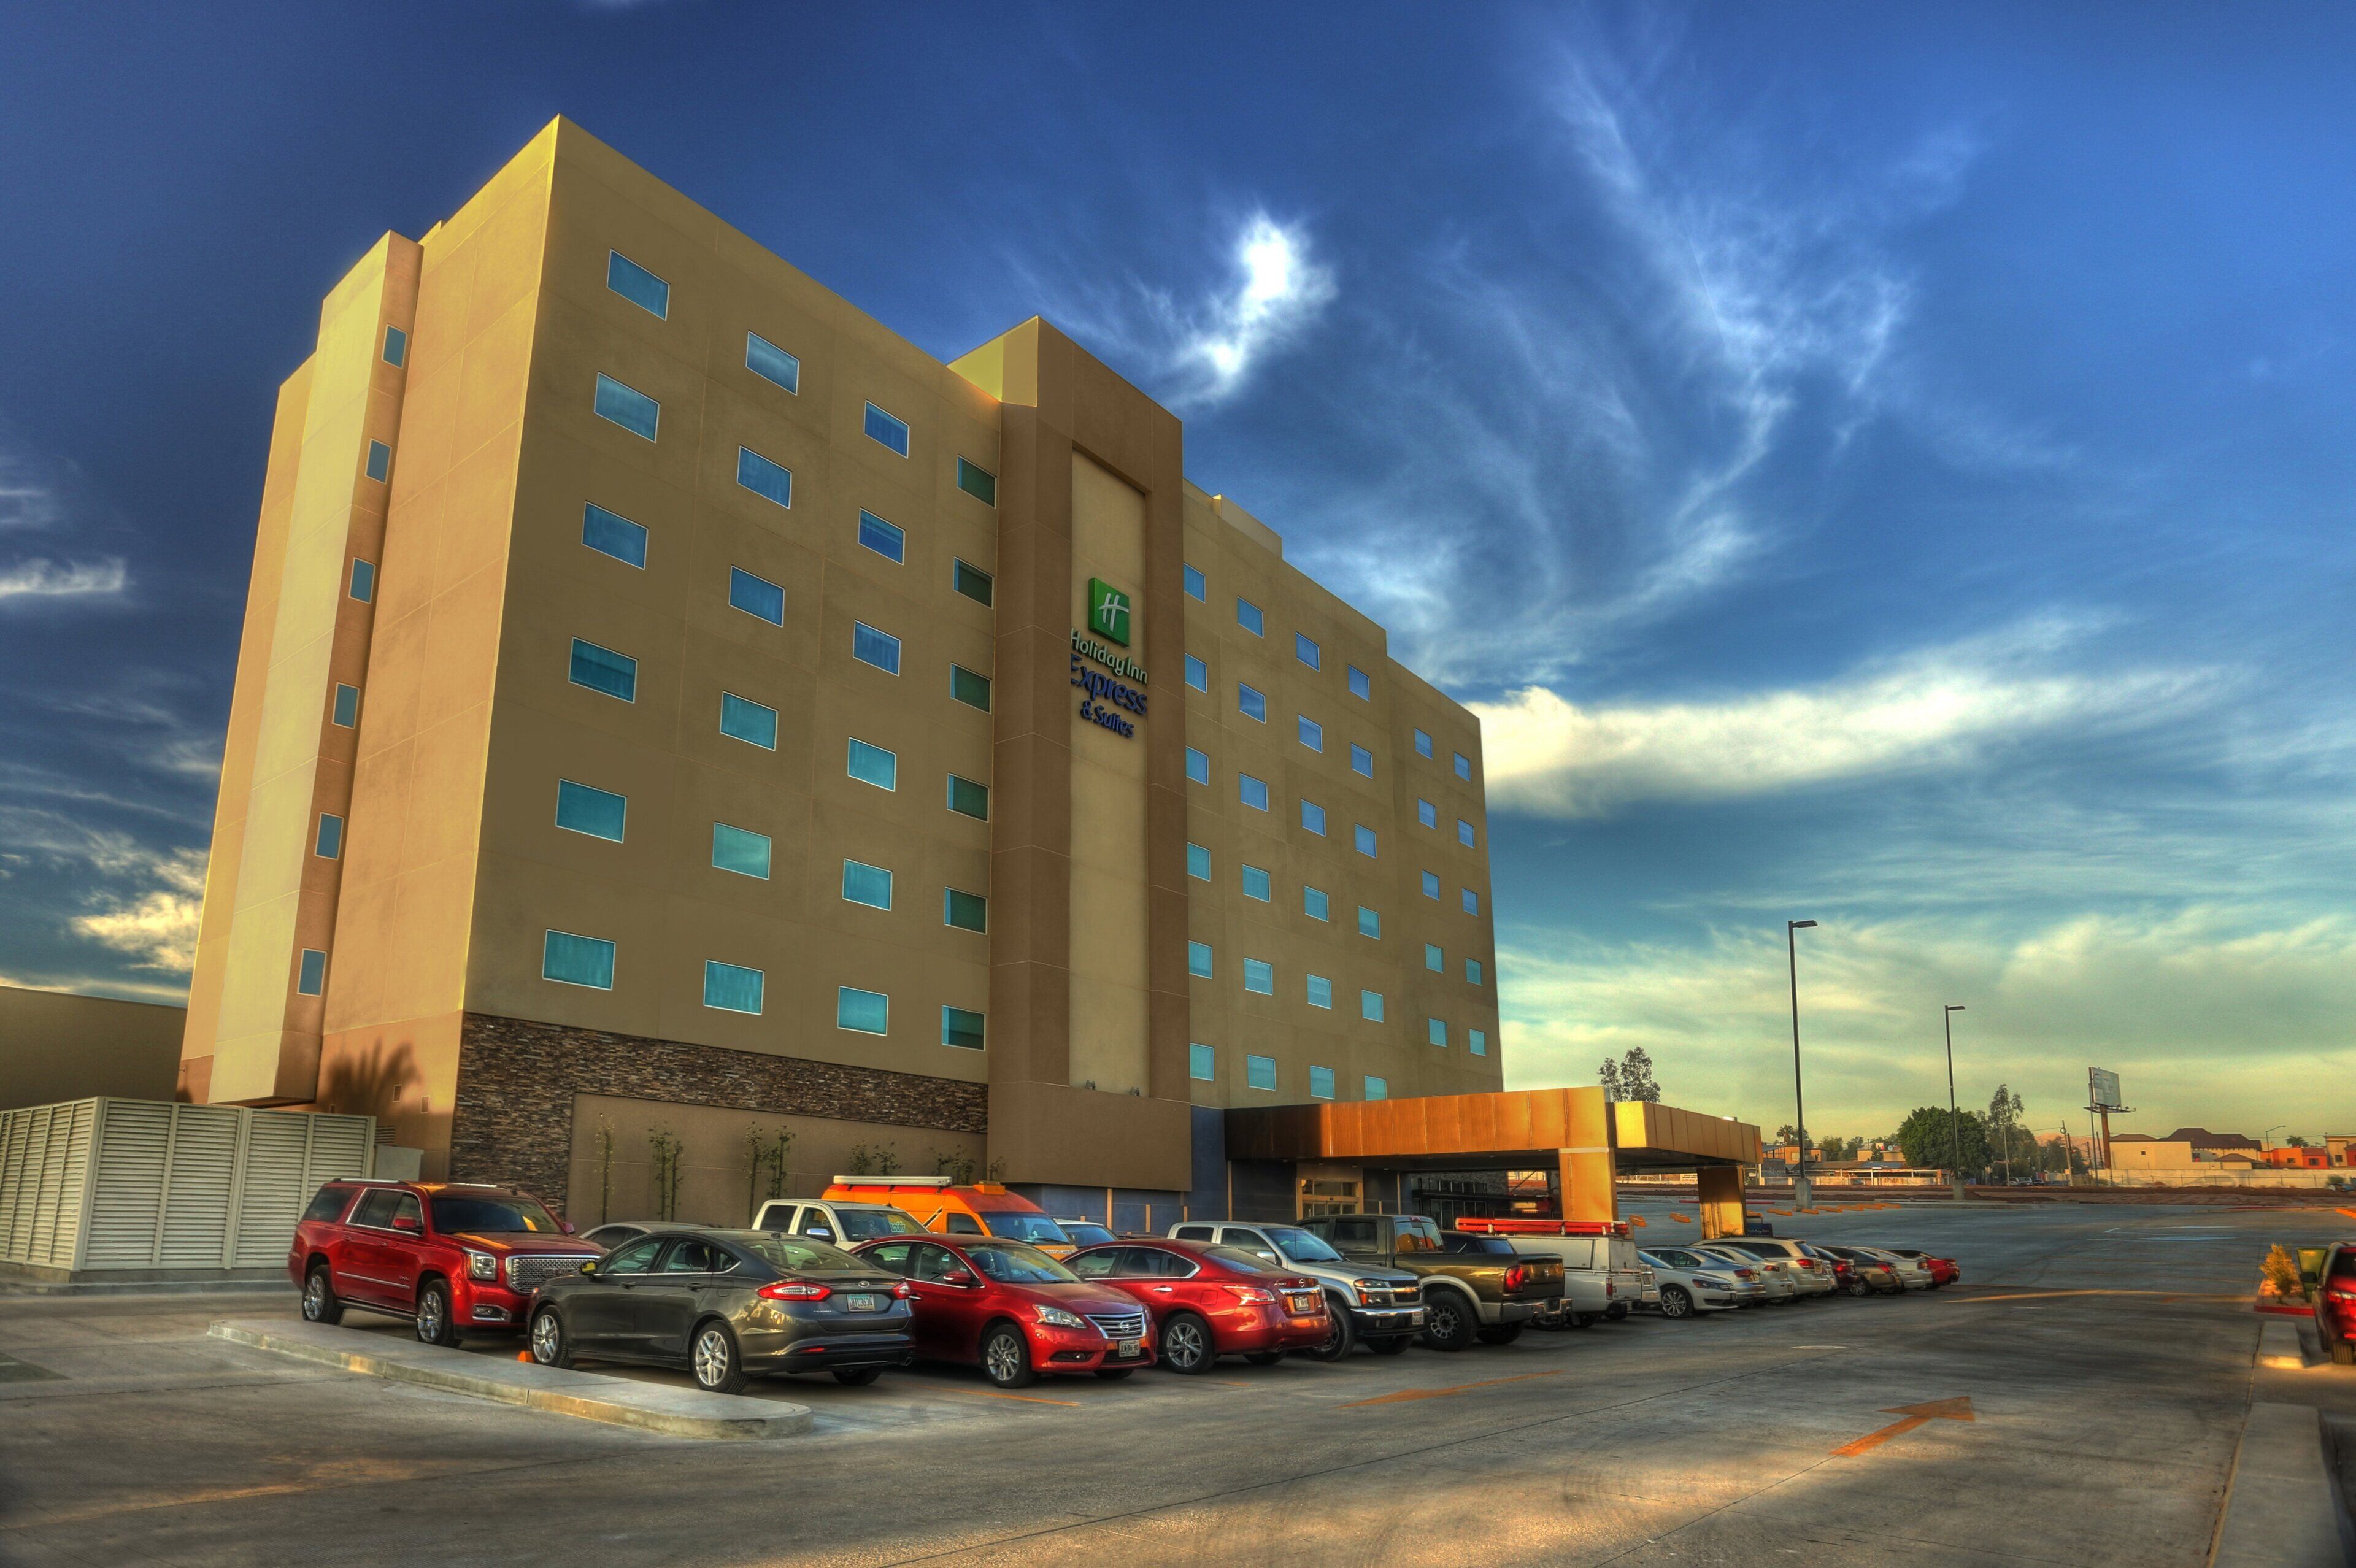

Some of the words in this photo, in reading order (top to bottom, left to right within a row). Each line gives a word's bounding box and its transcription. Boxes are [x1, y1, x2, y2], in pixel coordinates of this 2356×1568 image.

[1070, 628, 1125, 676] Holiday
[1126, 657, 1147, 683] Inn
[1071, 653, 1147, 715] Express
[1080, 700, 1093, 720] &
[1093, 705, 1134, 738] Suites
